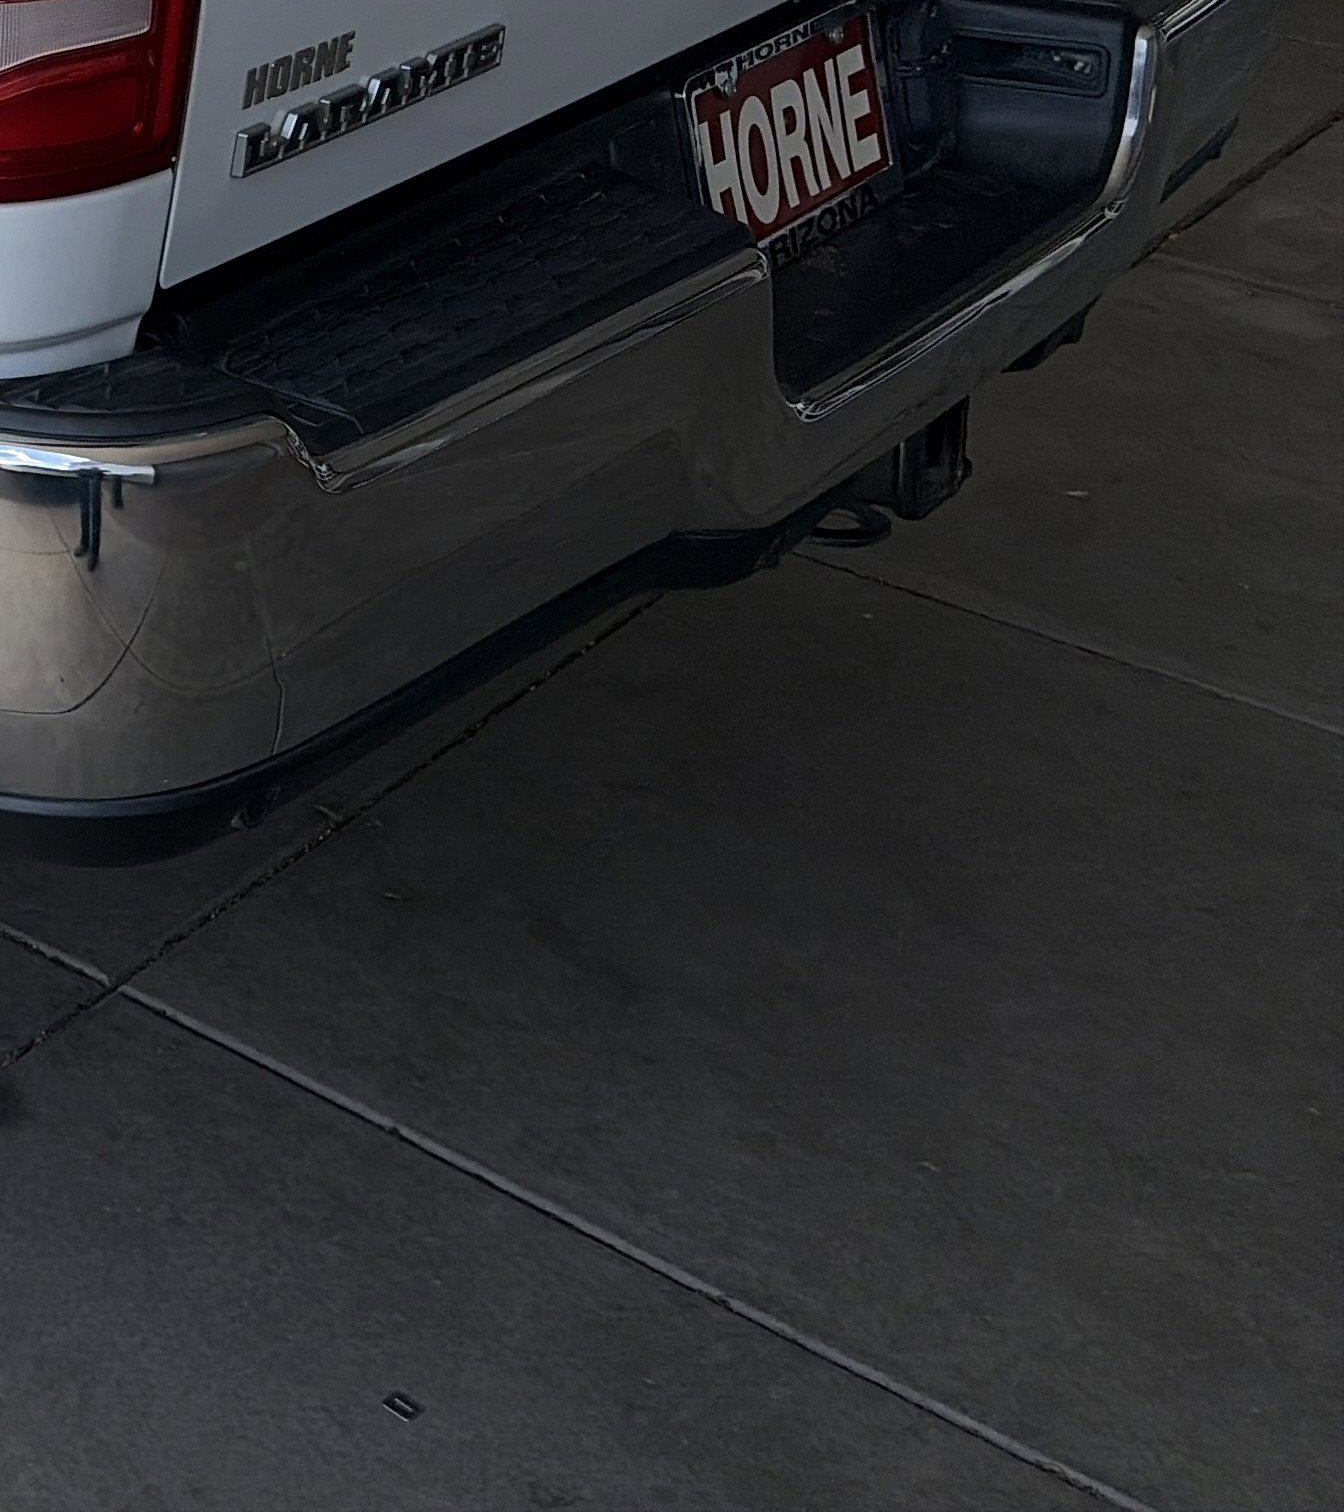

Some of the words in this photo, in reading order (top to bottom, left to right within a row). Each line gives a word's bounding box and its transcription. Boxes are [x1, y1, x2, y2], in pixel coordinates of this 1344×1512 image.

[241, 30, 356, 110] HORNE
[736, 19, 826, 72] HORNE
[230, 22, 505, 178] LARAMIE
[699, 43, 881, 225] HORNE
[766, 184, 880, 267] RIZONA
